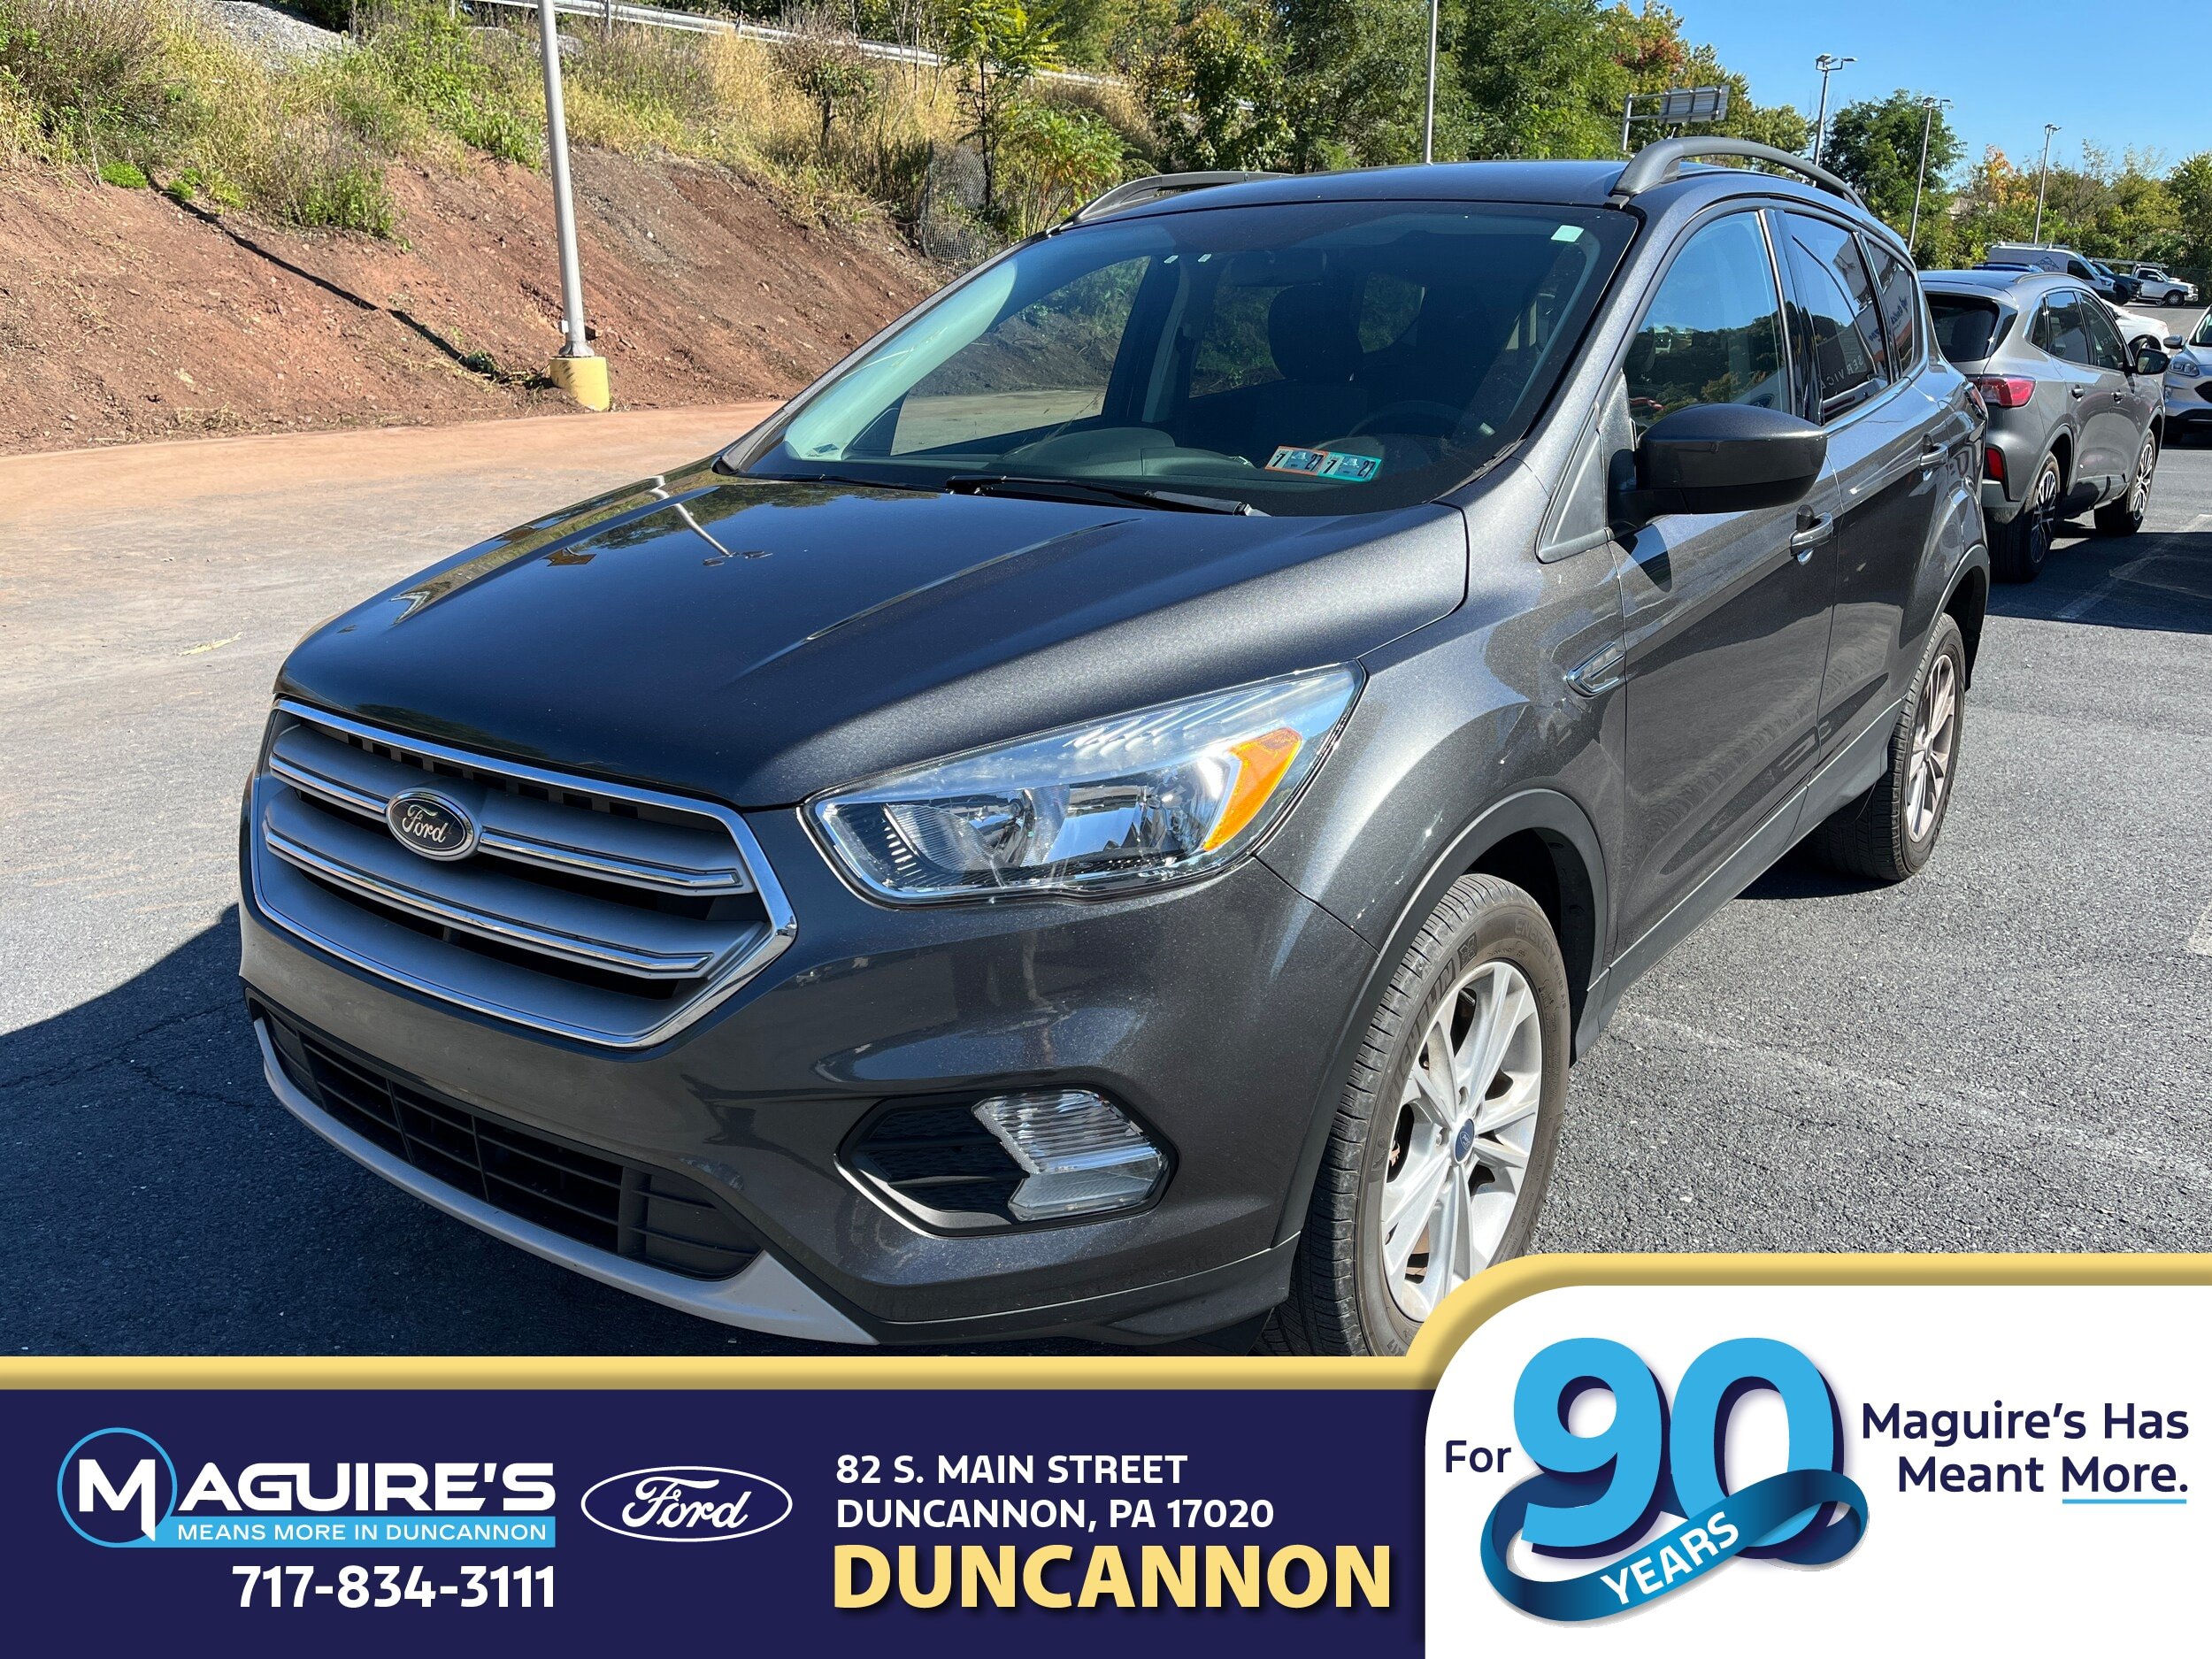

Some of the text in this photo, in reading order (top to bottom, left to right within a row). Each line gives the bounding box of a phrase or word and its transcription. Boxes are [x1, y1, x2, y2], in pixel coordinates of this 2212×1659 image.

[1305, 454, 1324, 472] 27
[1357, 460, 1376, 478] 27
[402, 804, 449, 843] Ford
